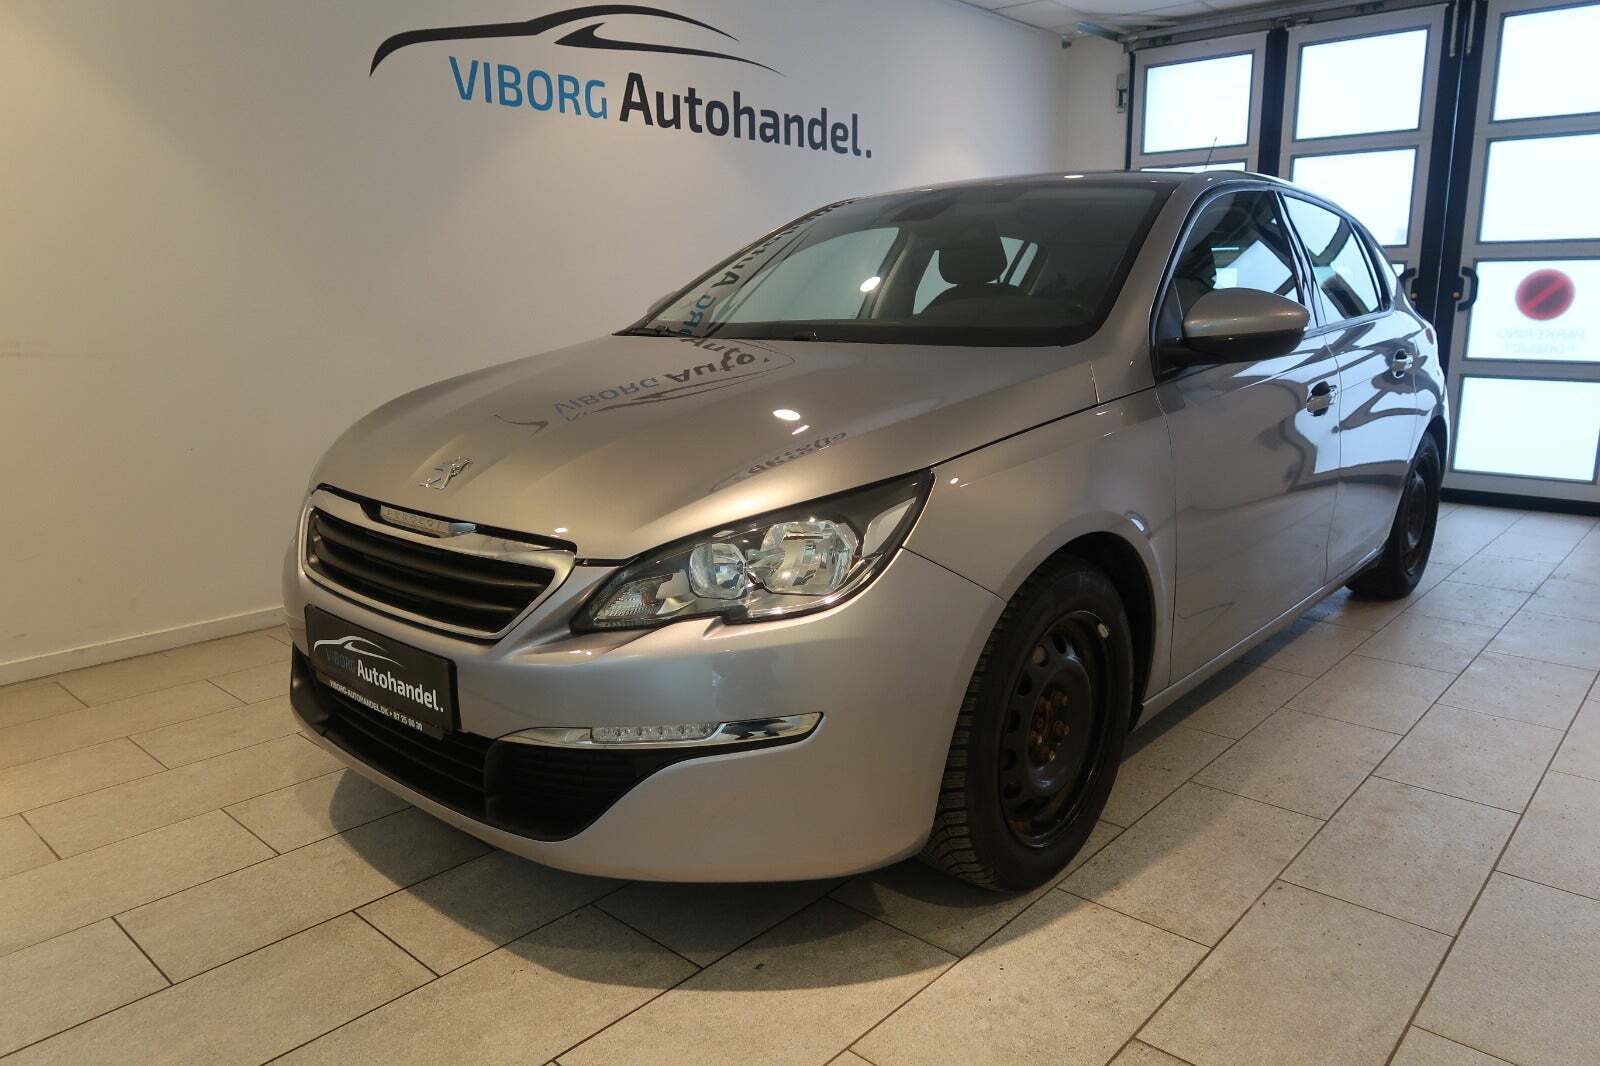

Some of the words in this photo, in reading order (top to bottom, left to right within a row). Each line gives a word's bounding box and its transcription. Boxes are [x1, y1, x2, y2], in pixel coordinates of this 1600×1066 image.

[448, 55, 607, 119] VIBORG
[619, 71, 872, 159] Autohandel.
[357, 659, 444, 713] Autohandel.
